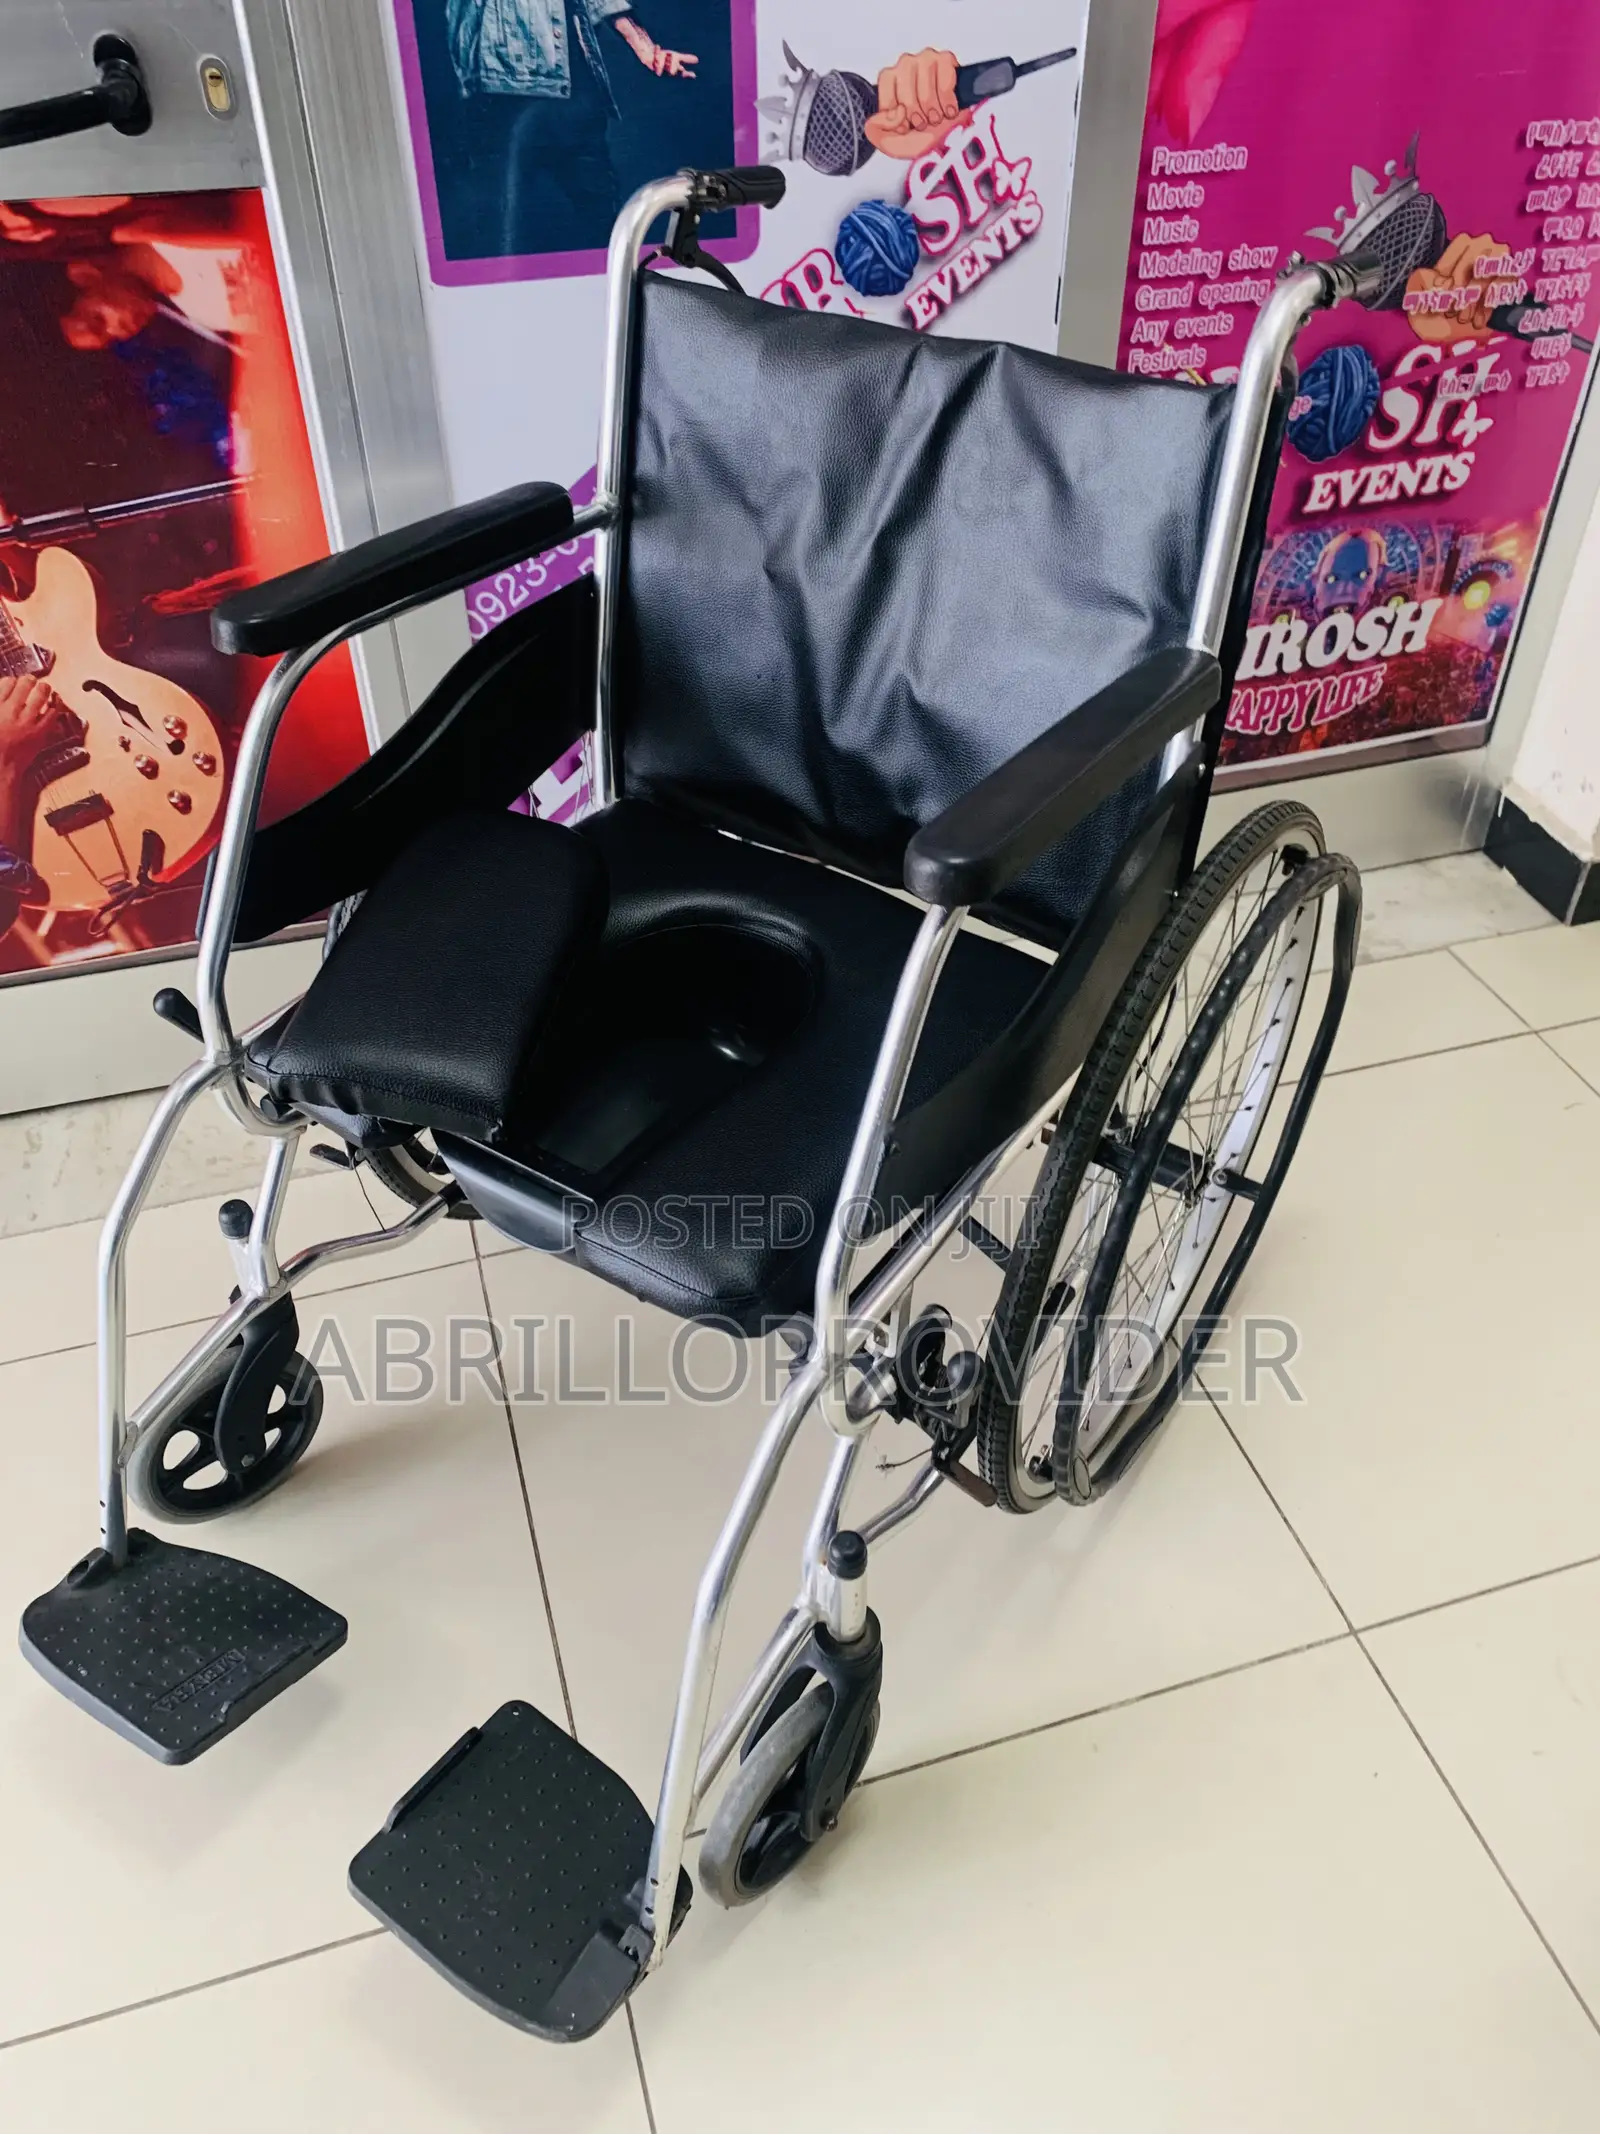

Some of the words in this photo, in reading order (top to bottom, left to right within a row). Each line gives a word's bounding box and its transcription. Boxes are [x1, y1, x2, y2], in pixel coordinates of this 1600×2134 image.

[1151, 142, 1248, 176] Promotion
[1146, 180, 1205, 211] Movie
[1142, 214, 1200, 246] Music
[904, 190, 1043, 332] EVENTS
[1138, 247, 1223, 280] Modeling
[1228, 243, 1278, 271] show
[1135, 281, 1194, 312] Grand
[1198, 276, 1271, 310] opening
[1130, 316, 1169, 347] Any
[1173, 310, 1234, 339] events
[1127, 343, 1207, 375] Festivals
[1303, 451, 1475, 513] EVENTS
[1309, 661, 1388, 727] LIFE
